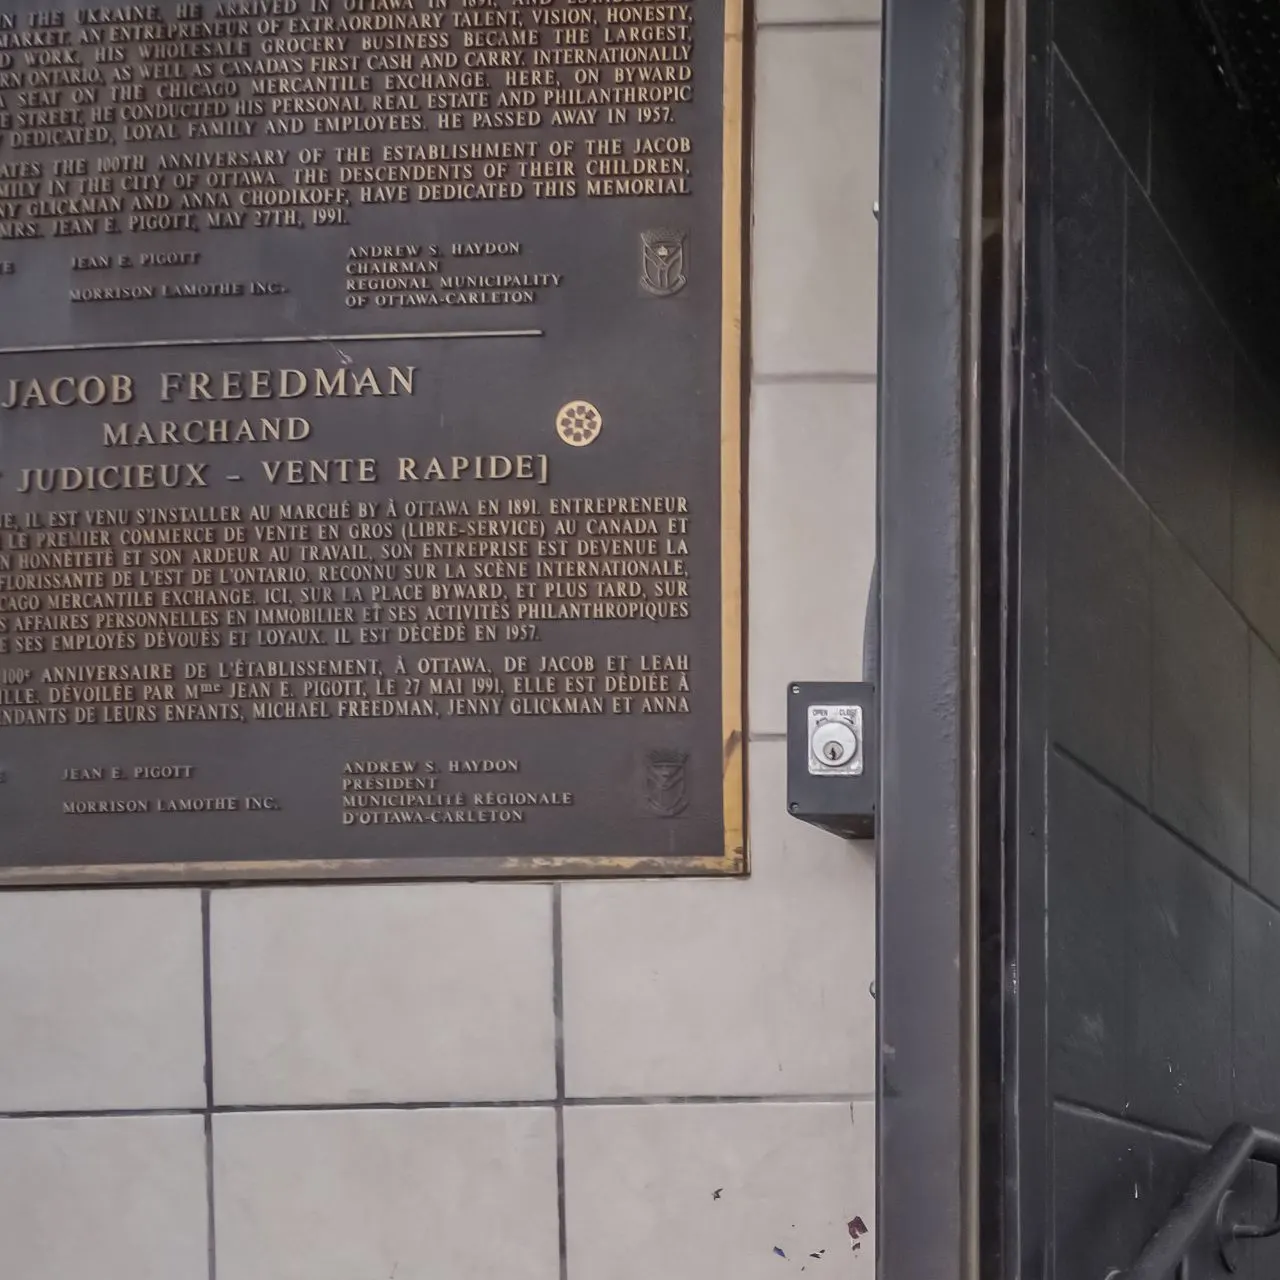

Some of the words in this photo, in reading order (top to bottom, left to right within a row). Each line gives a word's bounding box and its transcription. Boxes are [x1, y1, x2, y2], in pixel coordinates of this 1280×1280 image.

[11, 128, 115, 147] DEDICATED,
[123, 124, 178, 142] LOYAL
[188, 121, 251, 138] FAMILY
[265, 118, 305, 135] AND
[313, 114, 426, 132] EMPLOYEES.
[438, 113, 464, 130] HE
[472, 111, 542, 128] PASSED
[551, 109, 598, 126] AWAY
[607, 108, 627, 123] IN
[637, 107, 675, 123] 1957.
[52, 159, 87, 175] THE
[98, 155, 147, 172] 100TH
[158, 150, 289, 170] ANNIVERSARY
[299, 148, 323, 164] OF
[335, 147, 372, 163] THE
[383, 142, 538, 161] ESTABLISHMENT
[549, 140, 575, 157] OF
[585, 139, 623, 155] THE
[633, 137, 691, 154] JACOB
[71, 255, 112, 271] JEAN
[139, 251, 200, 267] PIGOTT
[348, 245, 421, 260] ANDREW
[451, 242, 521, 256] HAYDON
[346, 261, 440, 275] CHAIRMAN
[68, 285, 154, 303] MORRISON
[161, 283, 243, 298] LAMOTHE
[346, 277, 430, 292] REGIONAL
[440, 274, 563, 290] MUNICIPALITY
[346, 293, 366, 308] OF
[375, 291, 536, 307] OTTAWA-CARLETON
[1, 375, 134, 408] JACOB
[159, 366, 417, 401] FREEDMAN
[103, 417, 311, 447] MARCHAND
[17, 463, 209, 493] JUDICIEUX
[261, 458, 377, 484] VENTE
[26, 513, 41, 529] IL
[50, 511, 78, 528] EST
[85, 510, 129, 526] VENU
[136, 506, 242, 524] S'INSTALLER
[250, 505, 271, 521] AU
[279, 500, 350, 520] MARCHÉ
[358, 502, 379, 518] BY
[386, 498, 398, 517] À
[405, 500, 471, 518] OTTAWA
[478, 499, 499, 515] EN
[507, 499, 541, 516] 1891.
[549, 496, 688, 515] ENTREPRENEUR
[9, 533, 29, 549] LE
[36, 530, 111, 548] PREMIER
[120, 527, 216, 546] COMMERCE
[224, 526, 246, 543] DE
[255, 523, 309, 542] VENTE
[317, 523, 340, 540] EN
[349, 523, 393, 539] GROS
[402, 520, 545, 540] (LIBRE-SERVICE)
[554, 519, 577, 536] AU
[586, 518, 658, 535] CANADA
[668, 517, 688, 534] ET
[21, 548, 115, 568] HONNÊTETÉ
[123, 551, 141, 566] ET
[150, 550, 182, 565] SON
[192, 547, 259, 564] ARDEUR
[269, 547, 289, 562] AU
[301, 544, 374, 561] TRAVAIL,
[381, 543, 413, 559] SON
[423, 541, 529, 558] ENTREPRISE
[537, 540, 568, 557] EST
[577, 539, 657, 556] DEVENUE
[666, 538, 689, 555] LA
[41, 663, 172, 683] ANNIVERSAIRE
[184, 663, 207, 679] DE
[395, 655, 407, 674] À
[417, 656, 492, 674] OTTAWA,
[503, 656, 528, 673] DE
[539, 655, 594, 672] JACOB
[606, 655, 627, 671] ET
[640, 654, 689, 671] LEAH
[74, 706, 97, 722] DE
[103, 704, 156, 721] LEURS
[164, 702, 246, 722] ENFANTS,
[252, 701, 330, 719] MICHAEL
[337, 698, 440, 717] FREEDMAN,
[448, 697, 502, 716] JENNY
[510, 697, 602, 715] GLICKMAN
[612, 697, 632, 713] ET
[641, 696, 690, 713] ANNA
[61, 768, 102, 782] JEAN
[134, 766, 194, 779] PIGOTT
[343, 761, 415, 775] ANDREW
[449, 760, 519, 774] HAYDON
[62, 800, 148, 815] MORRISON
[156, 798, 238, 813] LAMOTHE
[474, 790, 573, 806] RÉGIONALE
[342, 809, 524, 824] D'OTTAWA-CARLETON
